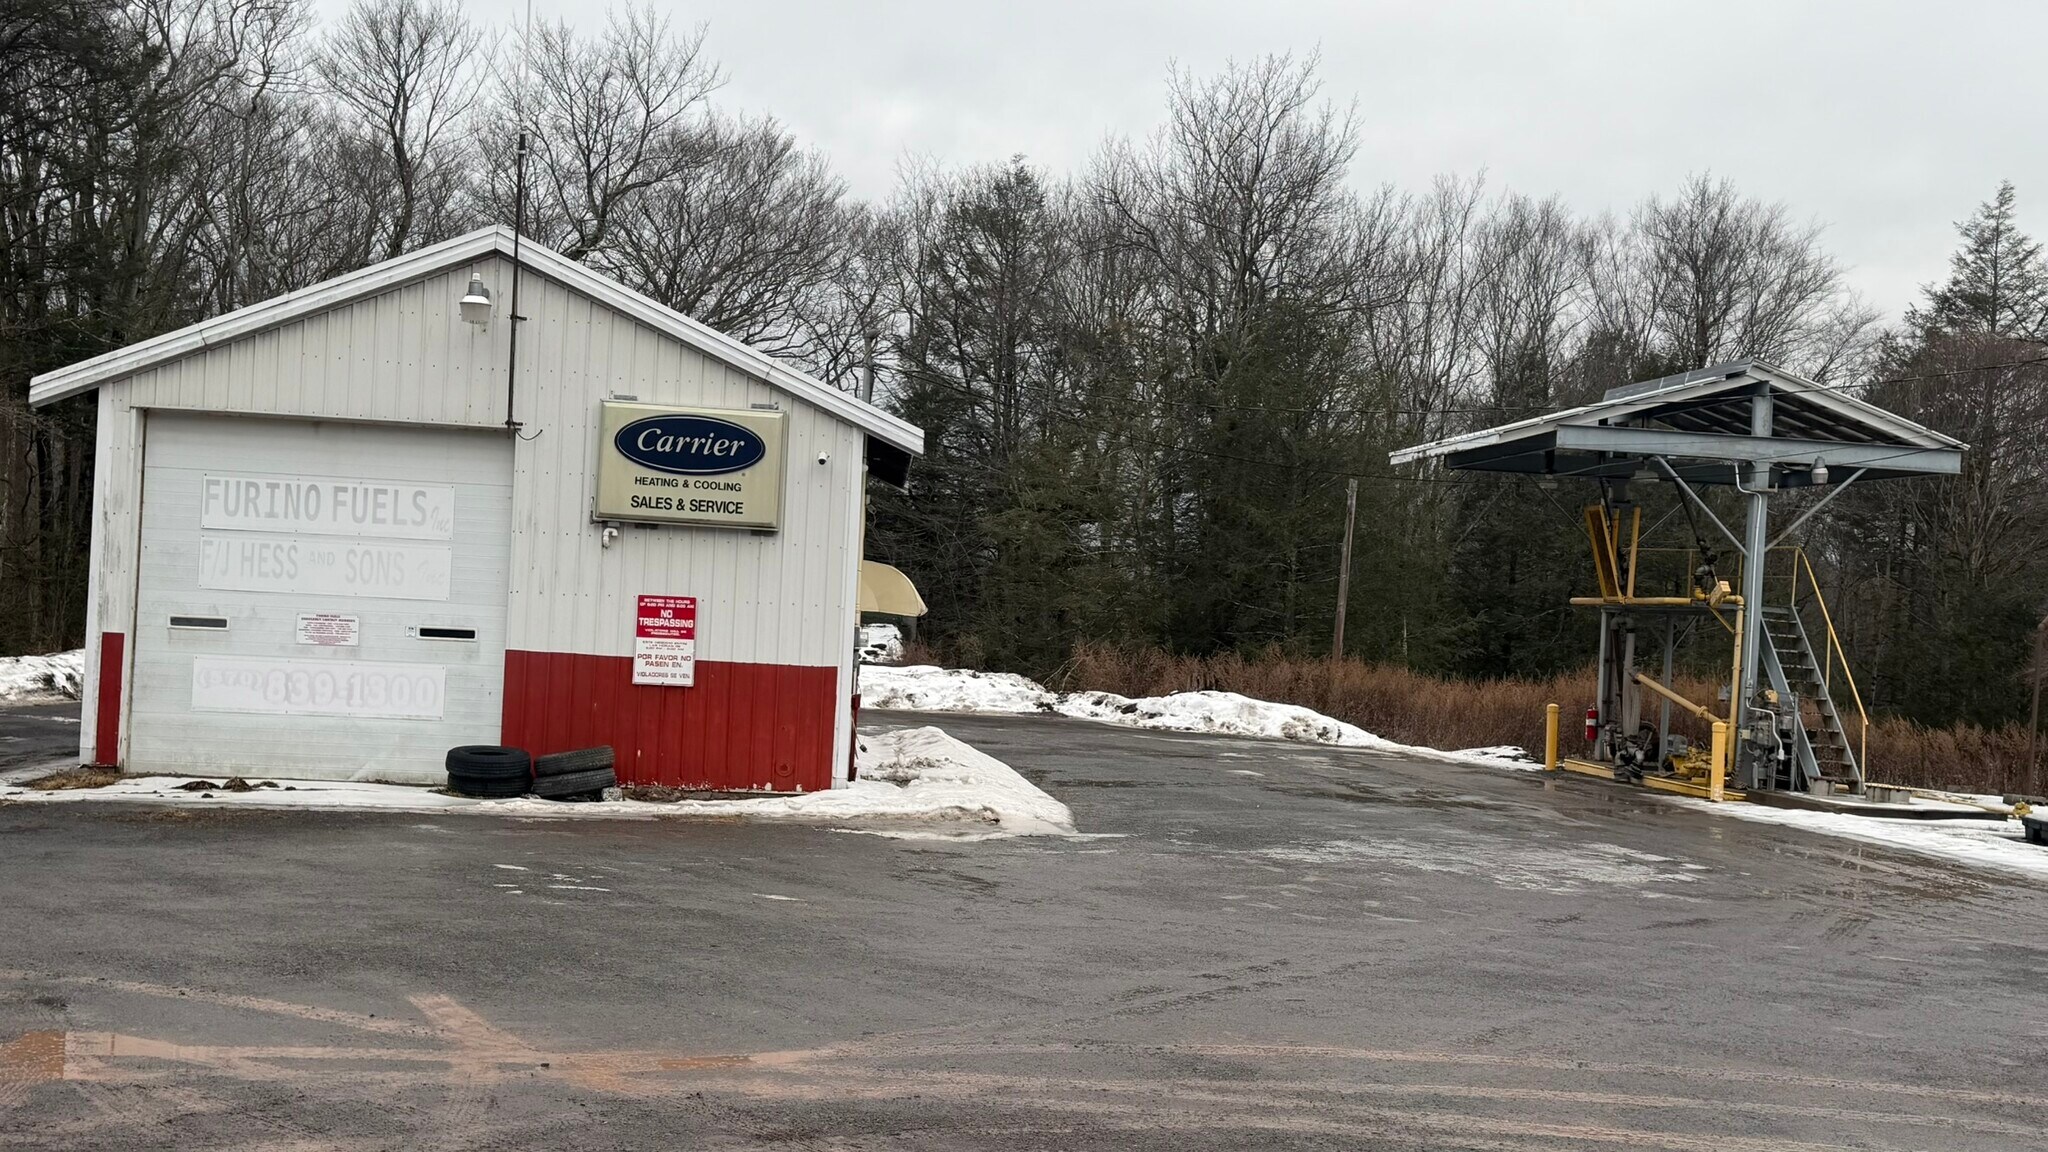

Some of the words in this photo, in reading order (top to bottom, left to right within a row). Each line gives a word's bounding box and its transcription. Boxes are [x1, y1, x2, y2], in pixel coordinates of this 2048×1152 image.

[637, 428, 745, 457] Carrier
[634, 476, 679, 488] HEATING
[682, 479, 690, 488] &
[693, 480, 742, 492] COOLING
[203, 479, 321, 521] FURINO
[331, 485, 427, 527] FUELS
[630, 495, 673, 511] SALES
[676, 498, 686, 511] &
[689, 499, 743, 514] SERVICE
[239, 542, 298, 580] HESS
[309, 551, 336, 568] AND
[344, 549, 405, 586] SONS
[638, 617, 694, 628] TRESPASSING
[660, 609, 673, 618] NO
